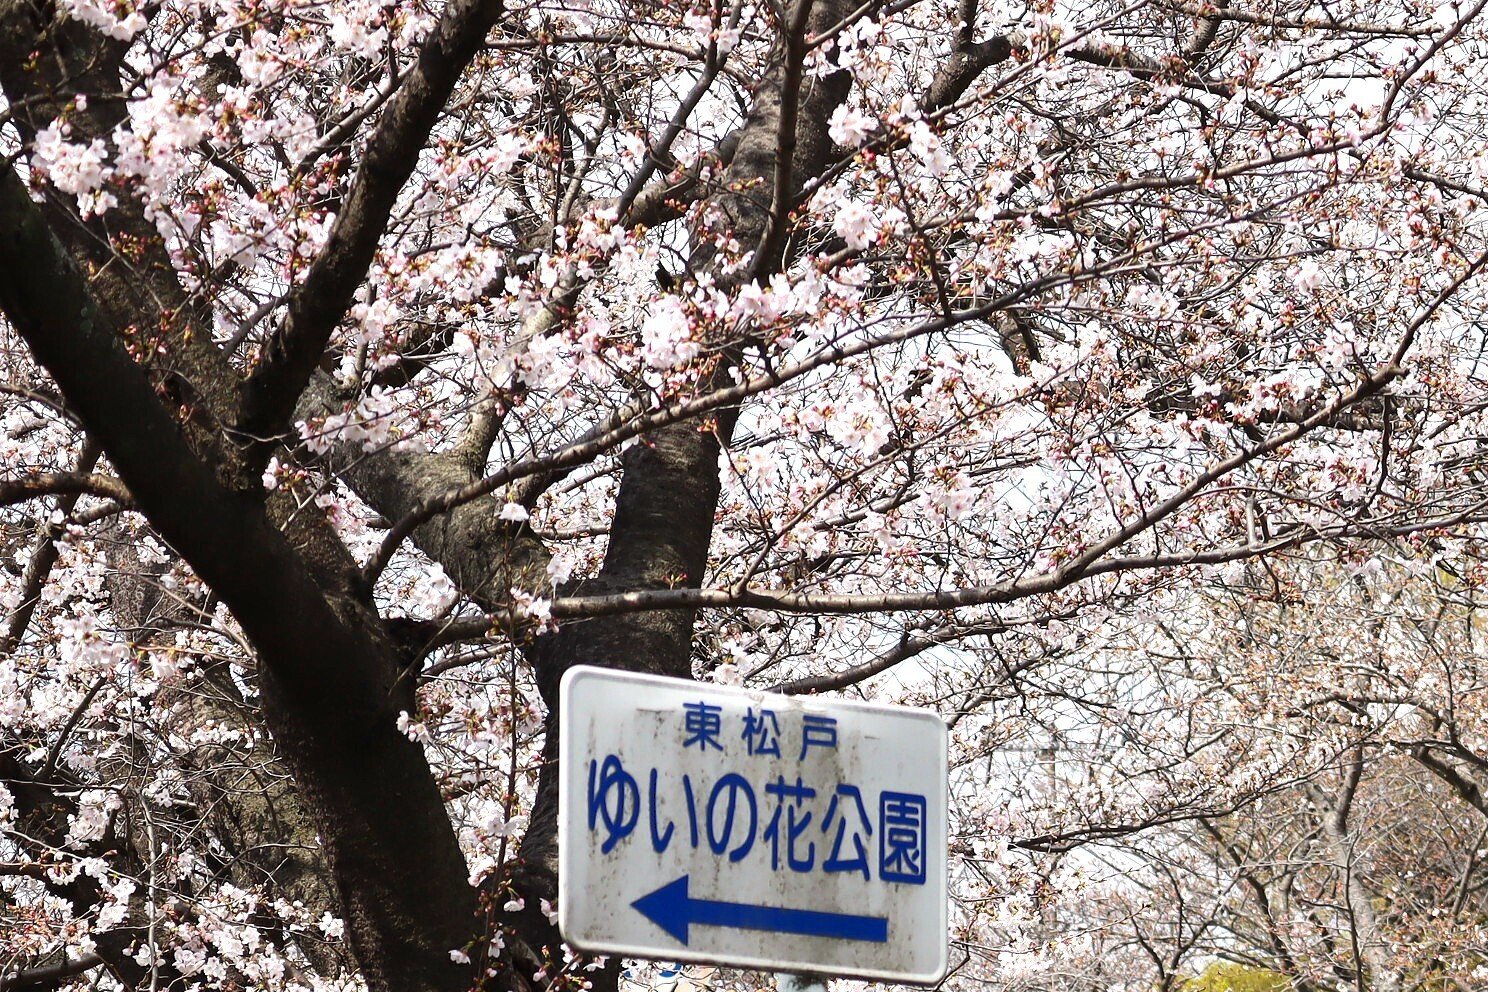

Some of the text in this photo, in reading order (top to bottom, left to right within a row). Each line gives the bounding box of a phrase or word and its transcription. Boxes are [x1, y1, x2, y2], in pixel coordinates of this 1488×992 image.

[682, 701, 838, 761] 東松戸
[587, 753, 928, 886] ゆいの花公園
